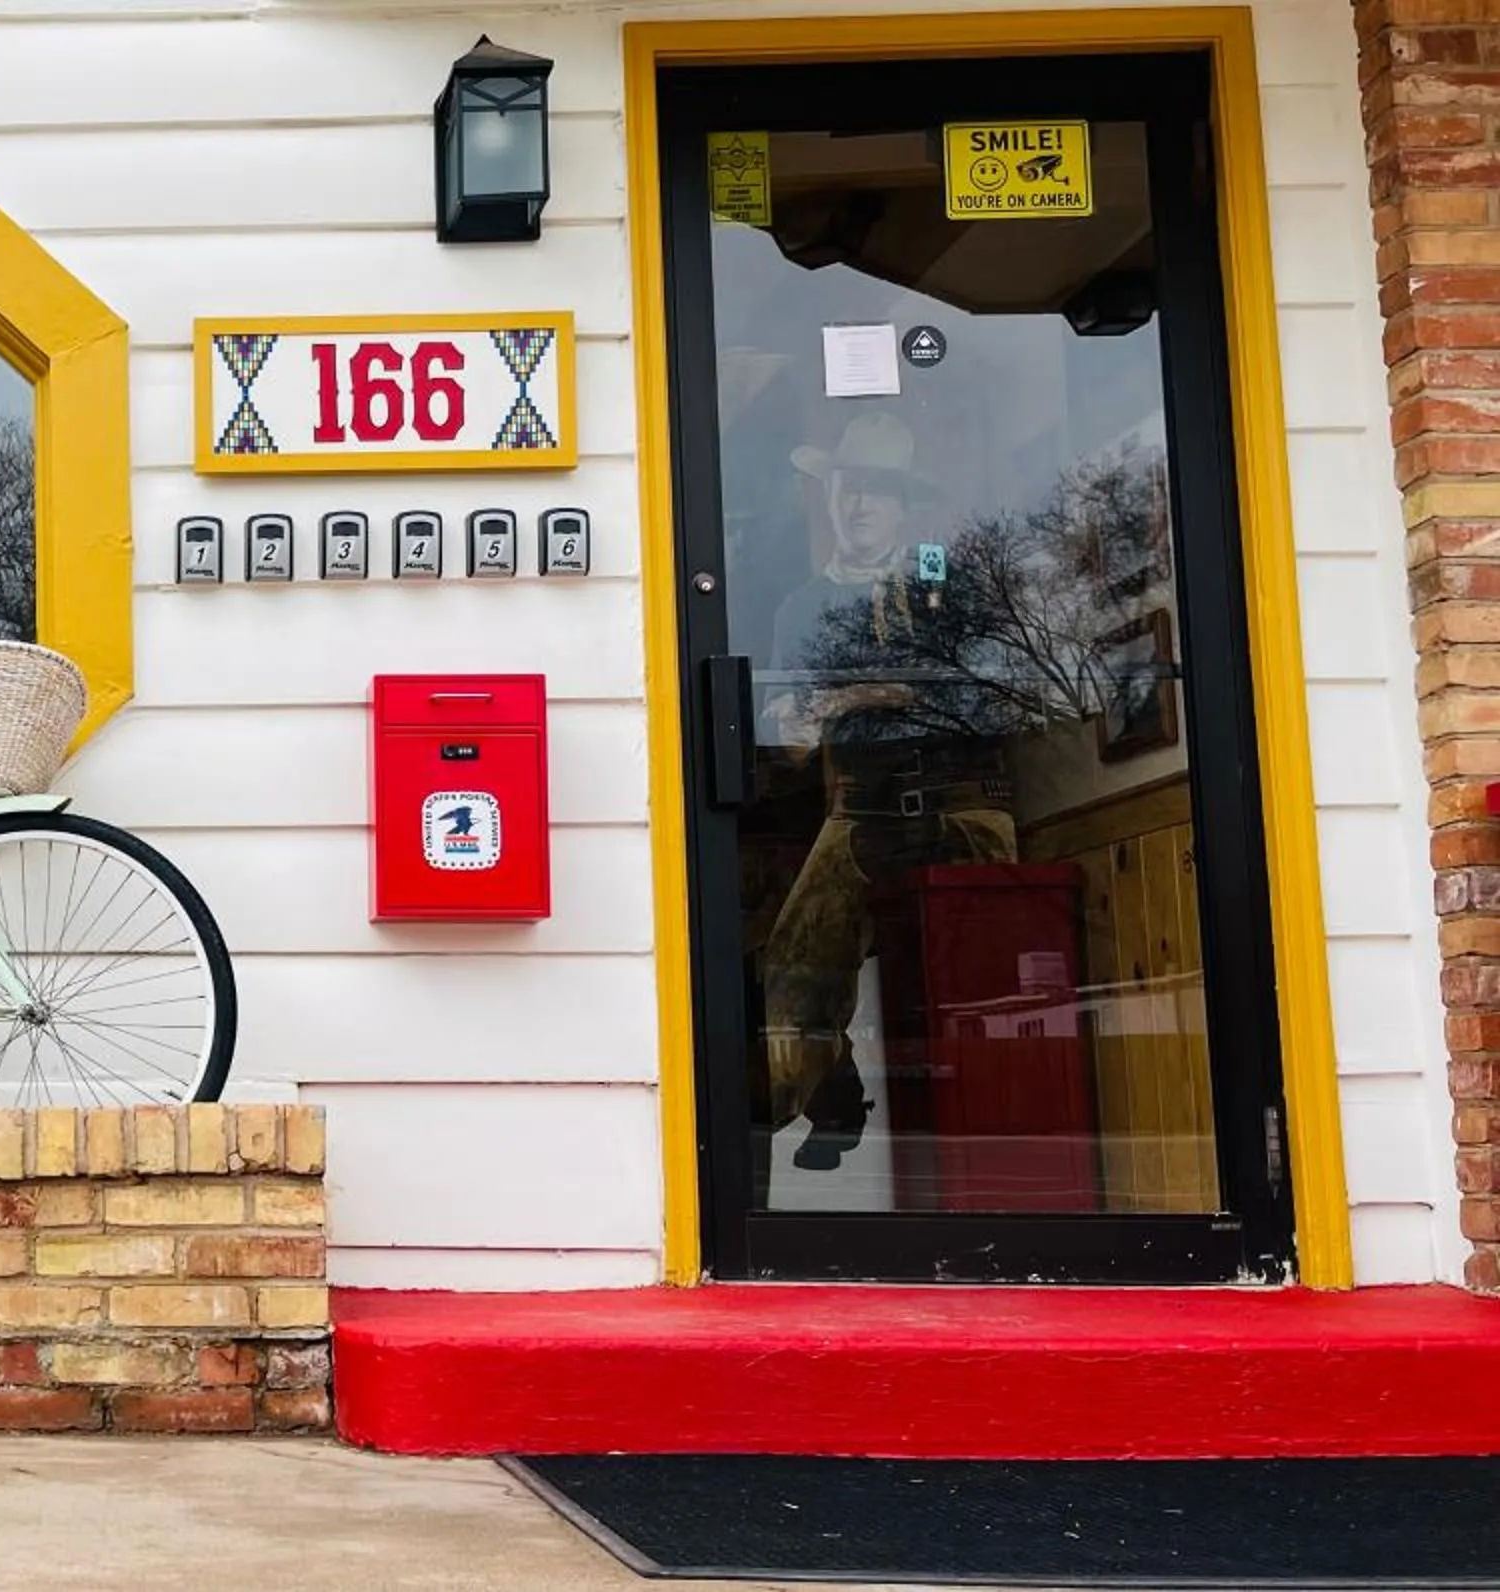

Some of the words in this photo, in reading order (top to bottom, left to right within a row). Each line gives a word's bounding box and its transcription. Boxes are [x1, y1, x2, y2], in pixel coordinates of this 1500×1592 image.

[970, 129, 1062, 152] SMILE!
[957, 193, 1002, 209] YOU'RE
[1007, 194, 1025, 207] ON
[1031, 192, 1081, 207] CAMERA
[311, 341, 465, 443] 166
[197, 547, 205, 565] 1
[262, 543, 277, 561] 2
[338, 541, 351, 559] 3
[412, 541, 425, 558] 4
[487, 540, 501, 558] 5
[562, 539, 576, 557] 6
